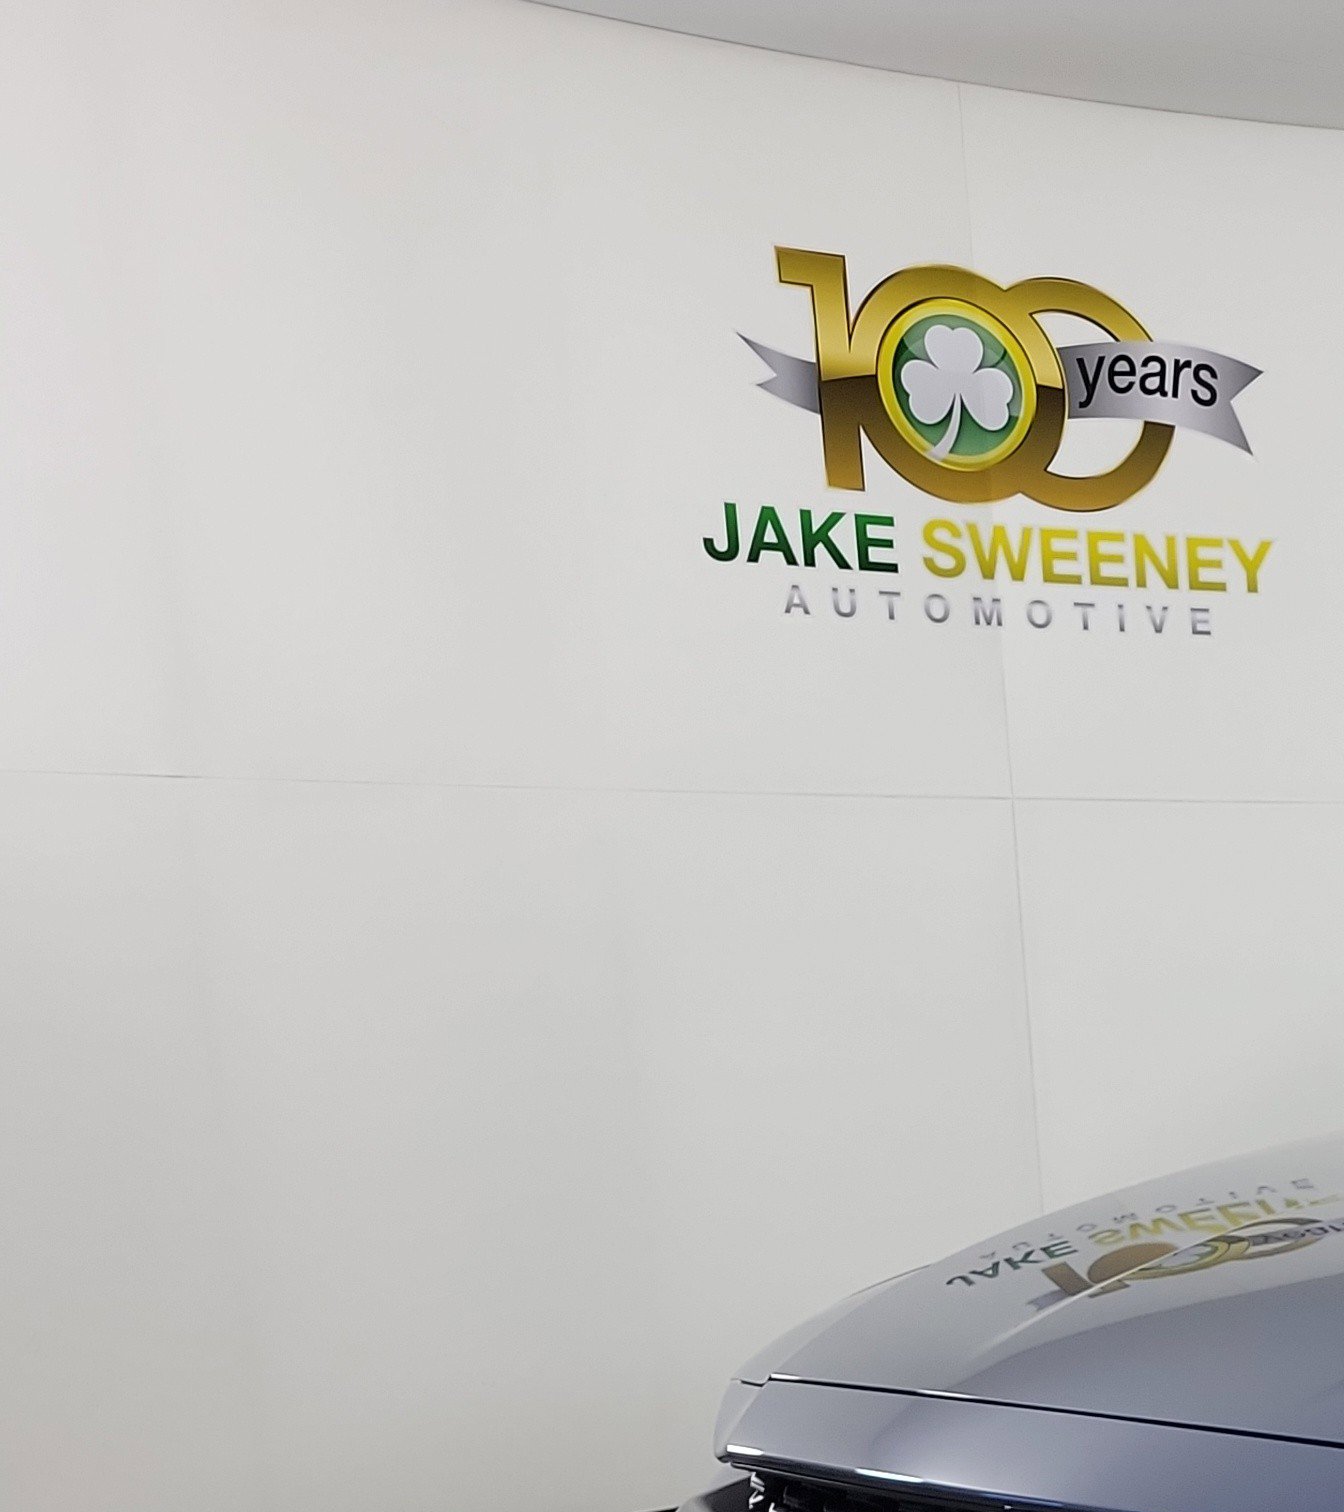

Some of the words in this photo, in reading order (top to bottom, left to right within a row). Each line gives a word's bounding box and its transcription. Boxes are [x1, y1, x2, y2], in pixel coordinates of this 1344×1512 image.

[774, 244, 1179, 514] 100
[1075, 353, 1220, 410] years
[702, 501, 900, 575] JAKE
[921, 518, 1275, 595] SWEENEY
[783, 583, 1213, 637] AUTOMOTIVE
